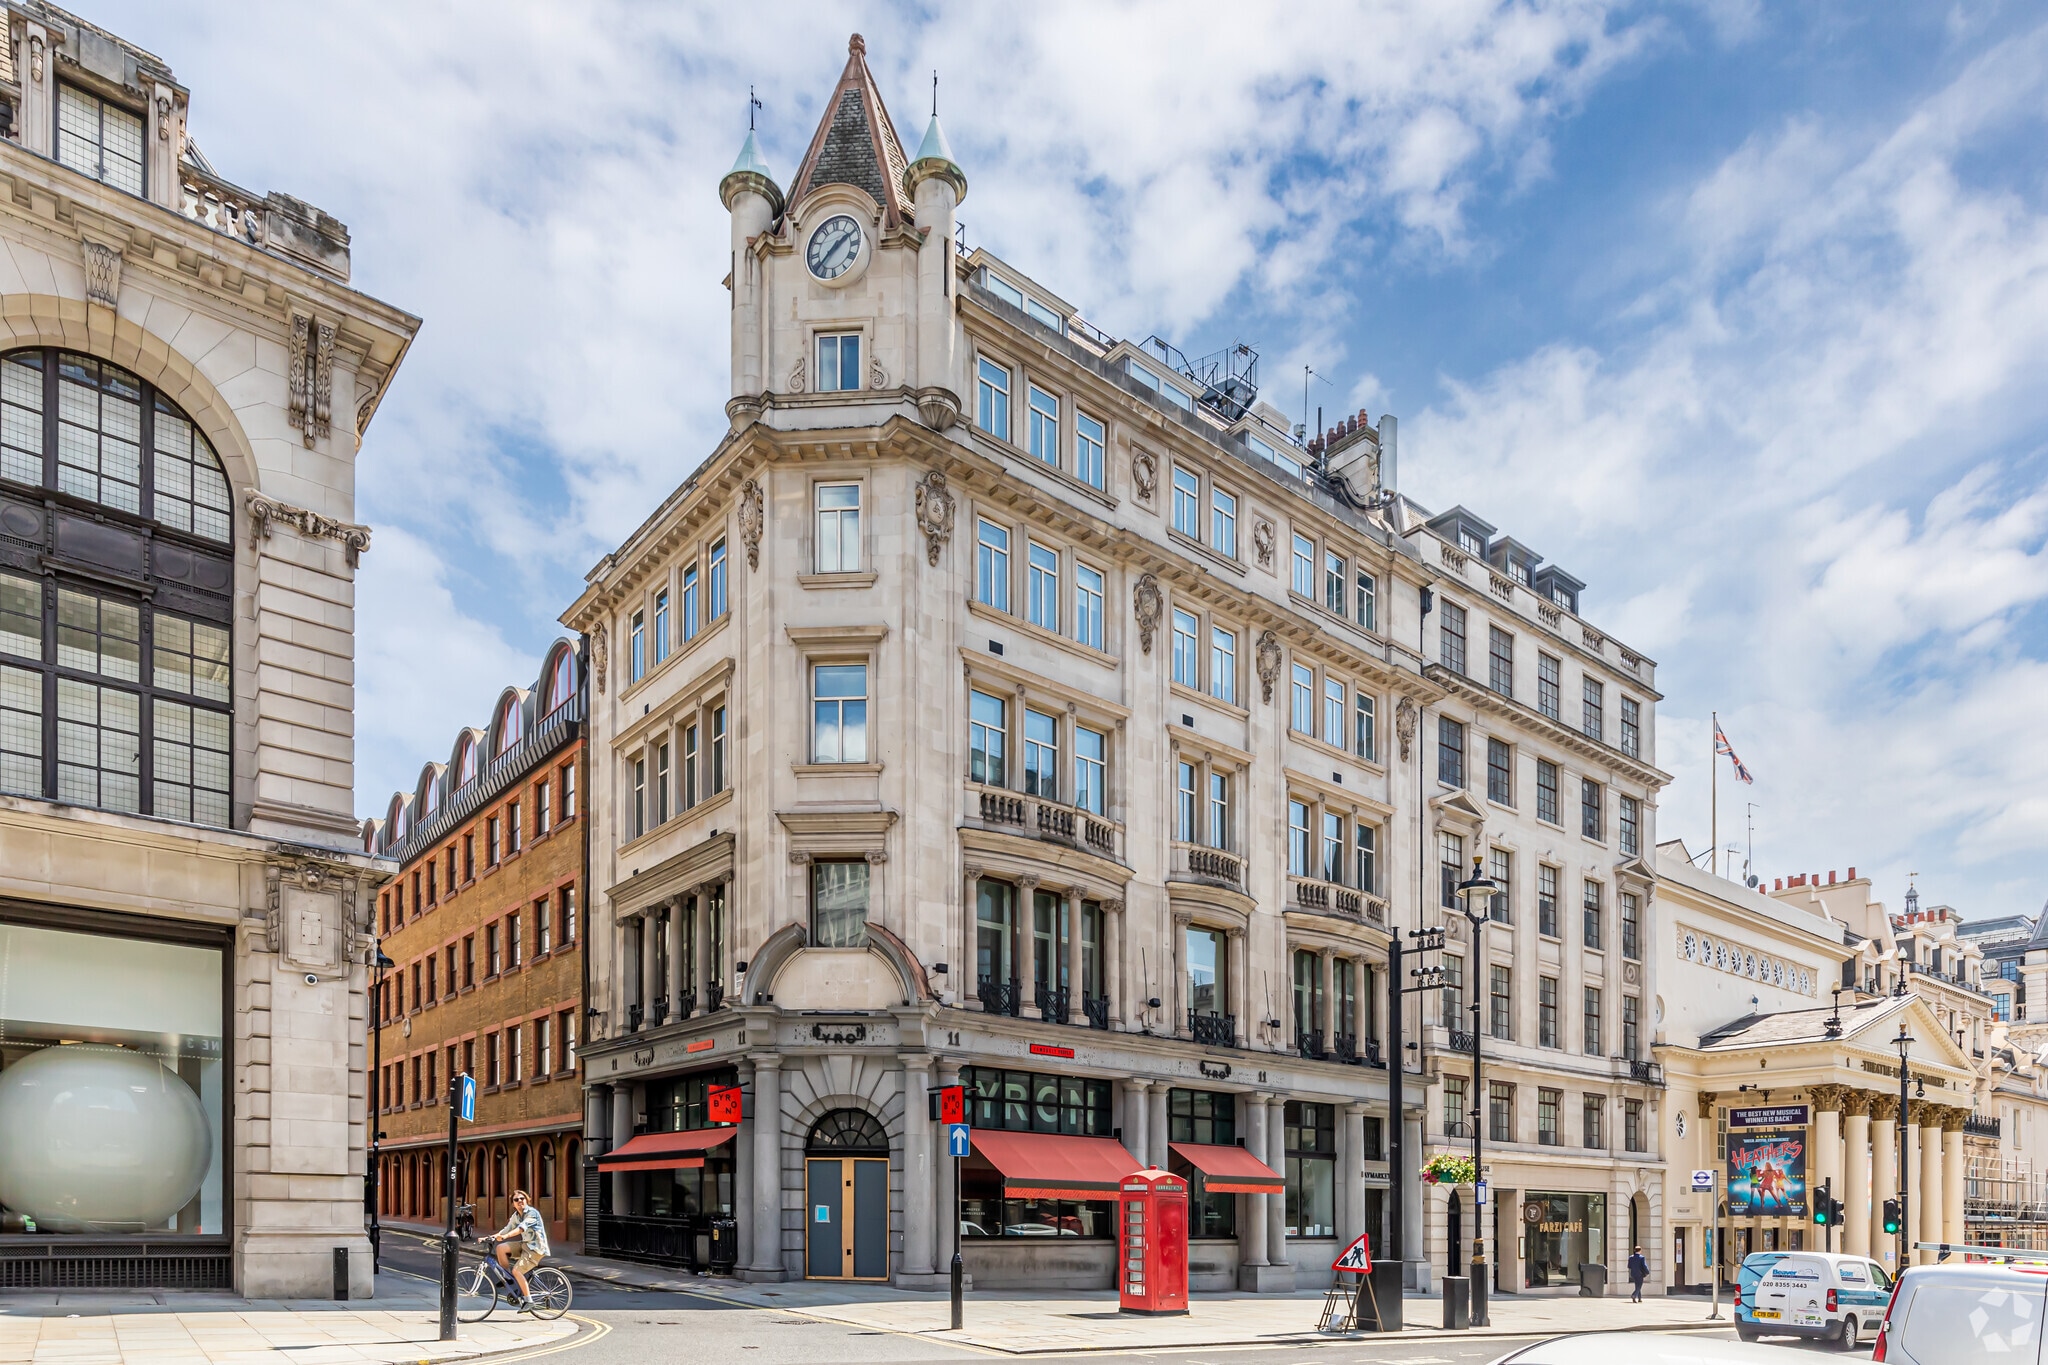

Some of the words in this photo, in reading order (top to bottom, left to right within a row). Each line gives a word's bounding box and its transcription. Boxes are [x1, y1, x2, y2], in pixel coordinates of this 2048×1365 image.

[947, 1031, 961, 1046] 11
[1862, 1060, 1892, 1076] THEATRE
[1776, 1108, 1802, 1116] MUSICAL
[1731, 1140, 1803, 1170] HEATHERS
[1540, 1222, 1562, 1232] FARZI
